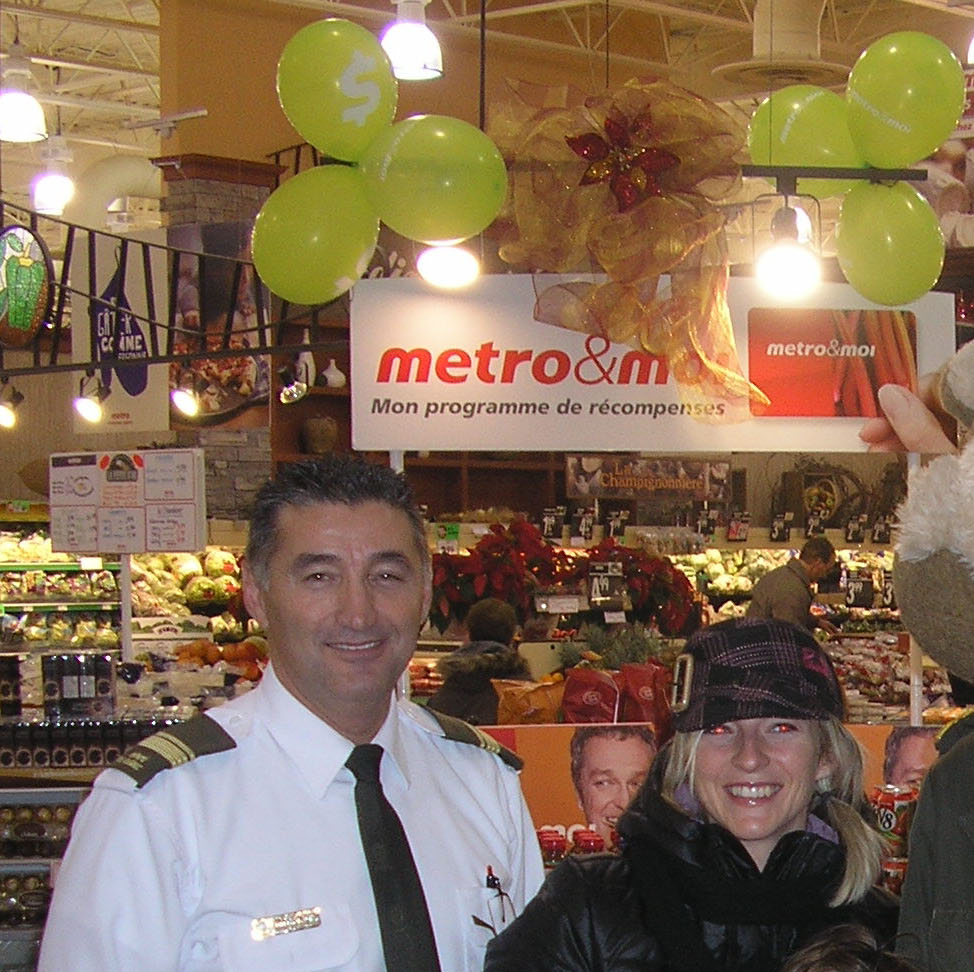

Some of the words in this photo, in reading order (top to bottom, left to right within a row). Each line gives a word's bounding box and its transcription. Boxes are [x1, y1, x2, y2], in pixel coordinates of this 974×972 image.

[767, 339, 876, 357] metro&moi
[371, 399, 418, 414] Mon
[425, 400, 549, 418] programme
[557, 398, 582, 415] de
[590, 398, 725, 420] récompenses
